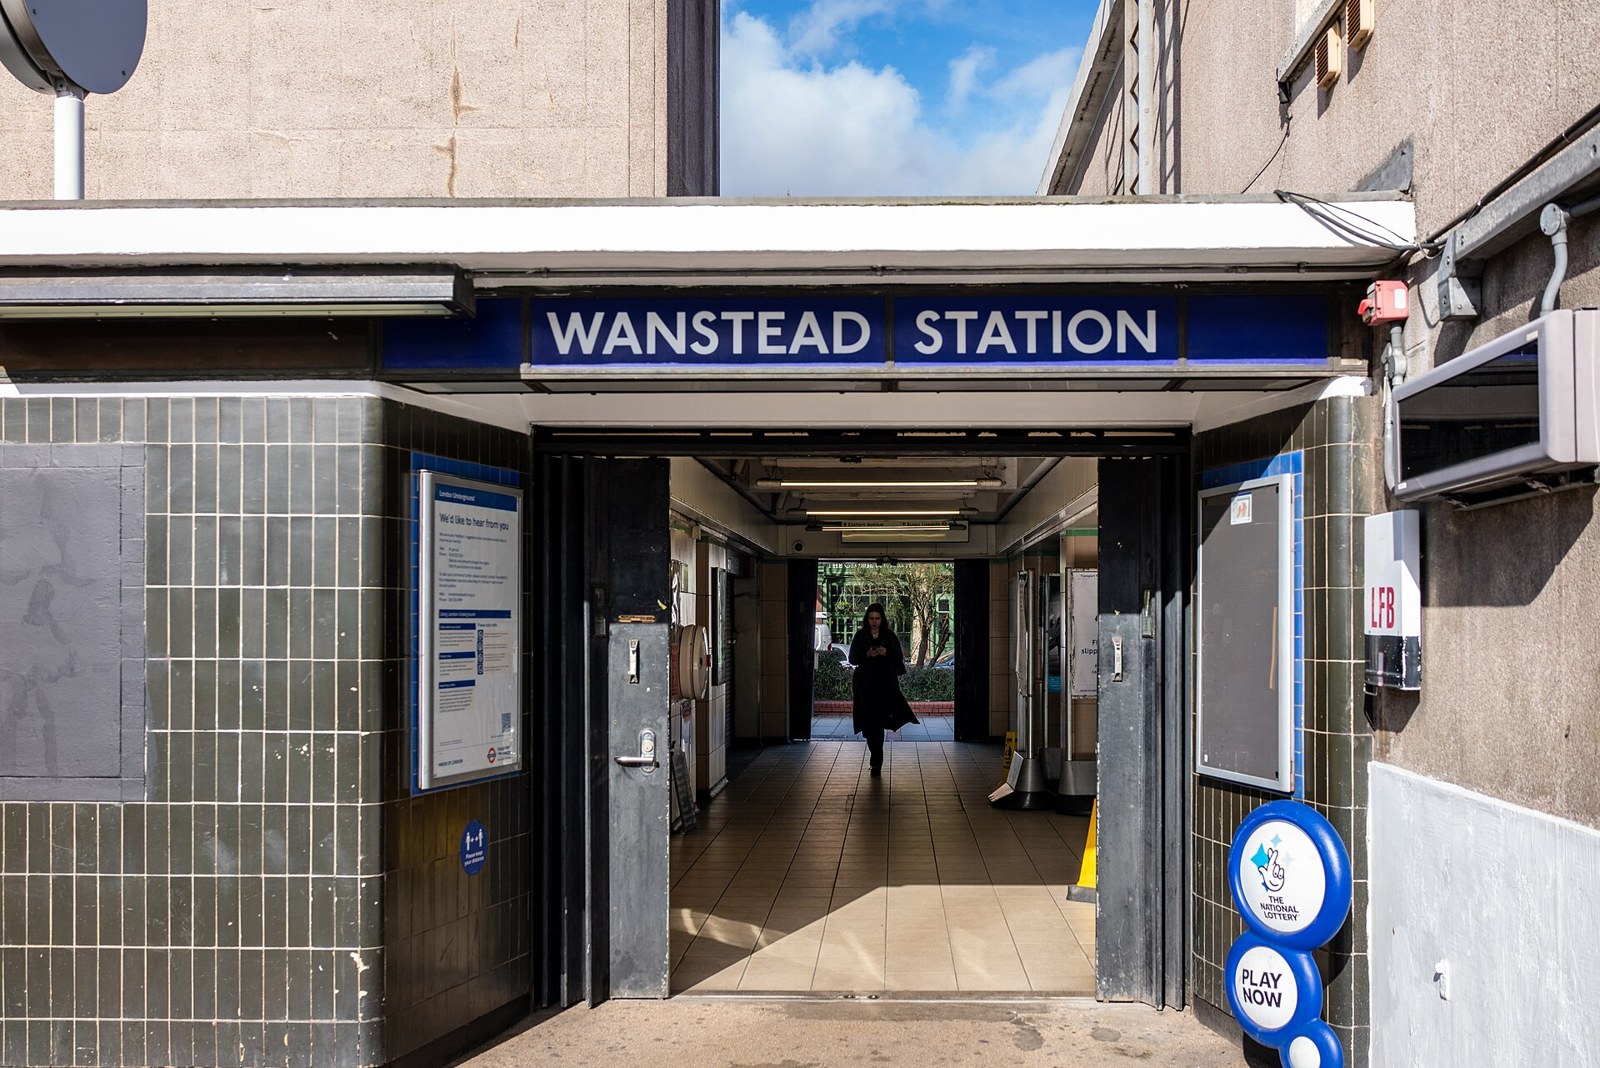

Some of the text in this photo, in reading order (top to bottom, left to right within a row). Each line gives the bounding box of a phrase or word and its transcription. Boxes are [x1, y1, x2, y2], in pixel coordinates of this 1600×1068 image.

[546, 310, 1157, 355] WANSTEAD STATION
[439, 513, 510, 532] We'd like to hear from you
[1371, 587, 1395, 628] LFB
[1260, 902, 1299, 913] NATIONAL
[1268, 895, 1284, 904] THE
[1264, 911, 1298, 921] LOTTERY
[1242, 968, 1282, 989] PLAY
[1242, 987, 1282, 1008] NOW
